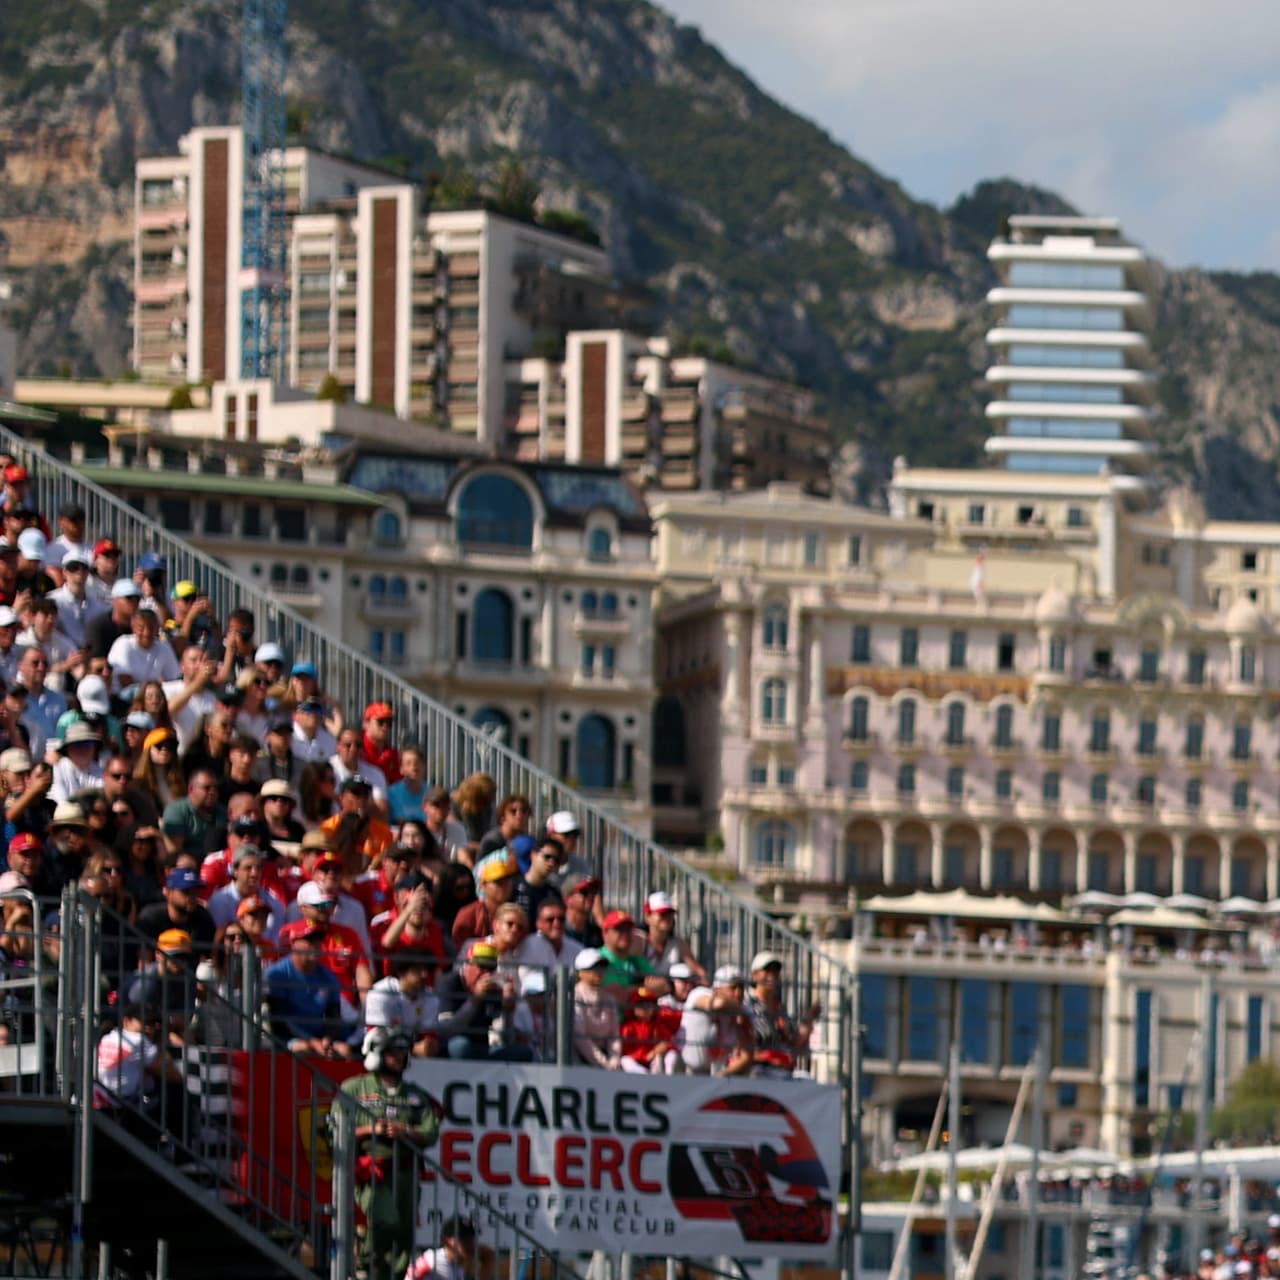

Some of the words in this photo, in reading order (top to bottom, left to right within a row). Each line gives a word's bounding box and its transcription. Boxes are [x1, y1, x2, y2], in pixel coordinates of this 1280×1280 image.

[443, 1081, 671, 1136] CHARLES
[419, 1130, 663, 1194] ECLERC
[526, 1193, 642, 1216] OFFICIAL
[554, 1213, 600, 1232] FAN
[613, 1217, 677, 1236] CLUB
